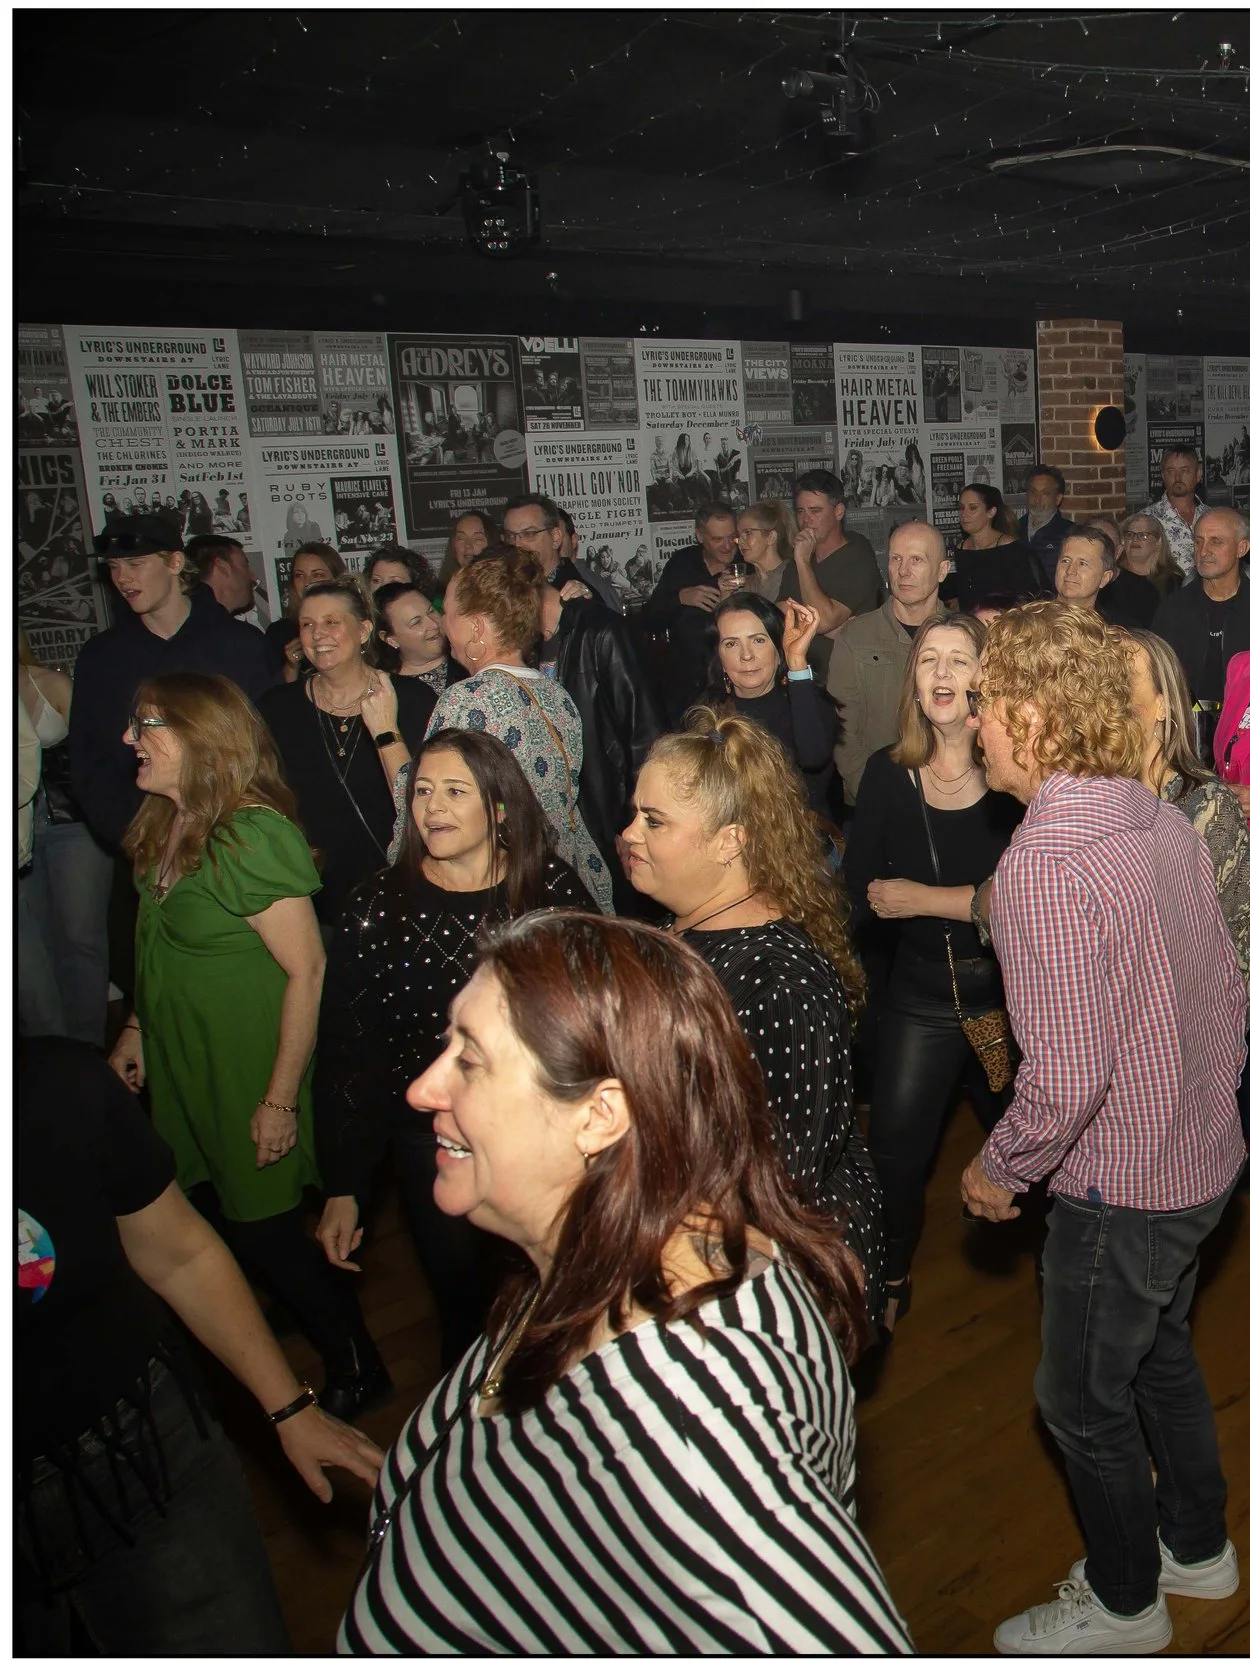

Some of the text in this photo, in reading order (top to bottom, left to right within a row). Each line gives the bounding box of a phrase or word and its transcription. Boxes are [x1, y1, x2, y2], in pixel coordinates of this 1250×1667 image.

[79, 339, 207, 354] LYRIC'S UNDERGROUND
[520, 336, 580, 354] VDELLI
[320, 353, 386, 366] HAIR METAL
[642, 350, 722, 362] LYRIC'S UNDERGROUND
[839, 354, 905, 364] LYRIC'S UNDERGROUND
[322, 368, 387, 387] HEAVEN
[744, 367, 789, 380] VIEWS
[85, 374, 159, 398] WILL STOKER
[166, 374, 234, 391] DOLCE
[247, 377, 317, 394] TOM FISHER
[840, 378, 917, 396] HAIR METAL
[643, 379, 663, 402] THE
[666, 379, 738, 401] TOMMYHAWKS
[168, 393, 236, 413] BLUE
[91, 402, 162, 423] & THE EMBERS
[843, 400, 918, 426] HEAVEN
[173, 426, 240, 437] PORTIA
[251, 417, 287, 433] SATURDAY
[646, 421, 685, 431] Saturday
[686, 420, 728, 428] December
[95, 438, 165, 447] CHEST
[176, 438, 241, 449] & MARK
[844, 437, 876, 449] Friday
[877, 437, 898, 449] July
[97, 451, 167, 460] THE CHLORINES
[262, 448, 370, 462] LYRIC'S UNDERGROUND
[533, 445, 564, 456] LYRIC'S
[565, 443, 623, 454] UNDERGROUND
[277, 462, 343, 471] DOWNSTAIRS
[99, 473, 167, 486] Fri Jan 31
[180, 471, 244, 483] Sat Feb 1st
[269, 482, 326, 492] RUBY
[535, 473, 587, 497] FLYBALL
[271, 493, 327, 502] BOOTS
[591, 499, 612, 508] MOON
[613, 497, 641, 506] SOCIETY
[606, 508, 643, 519] FIGHT
[380, 532, 394, 542] 23
[590, 530, 631, 541] January
